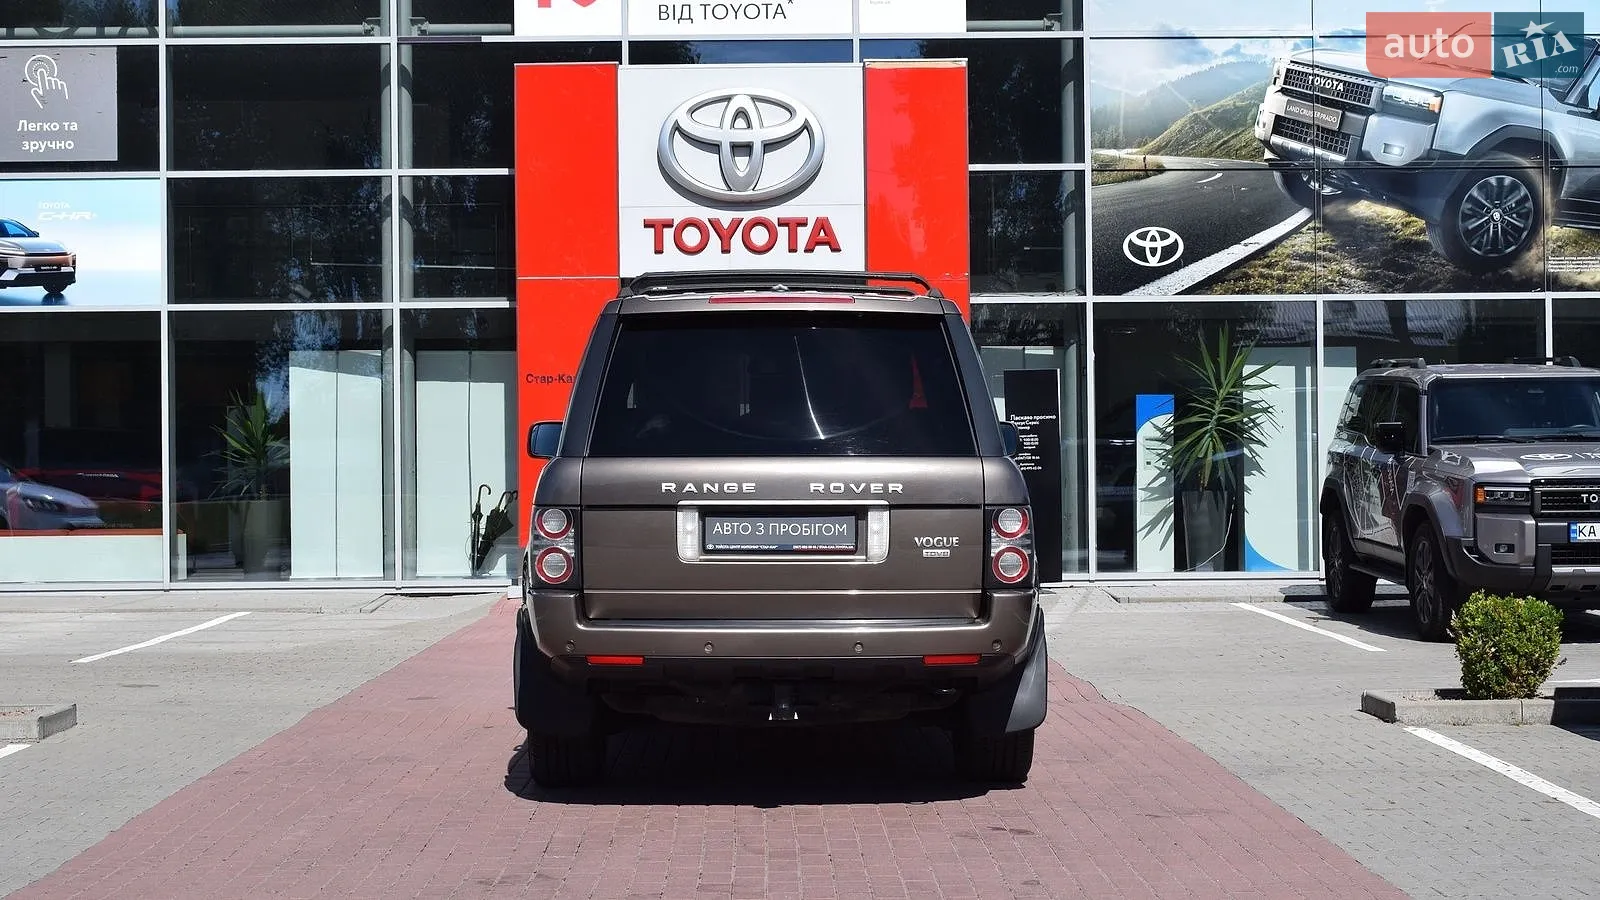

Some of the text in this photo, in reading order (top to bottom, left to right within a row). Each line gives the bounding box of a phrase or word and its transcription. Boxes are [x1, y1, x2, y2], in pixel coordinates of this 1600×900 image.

[658, 4, 693, 24] ВІД
[1308, 75, 1344, 92] TOYOTA
[1286, 104, 1337, 123] LAND CRUISER PRADO
[17, 119, 78, 132] Легко та
[22, 140, 75, 153] зручно
[643, 216, 842, 256] TOYOTA
[525, 373, 575, 385] Стар-Ка
[661, 482, 904, 494] RANGE ROVER
[712, 522, 847, 536] АВТО З ПРОБІГОМ
[914, 536, 960, 548] VOGUE
